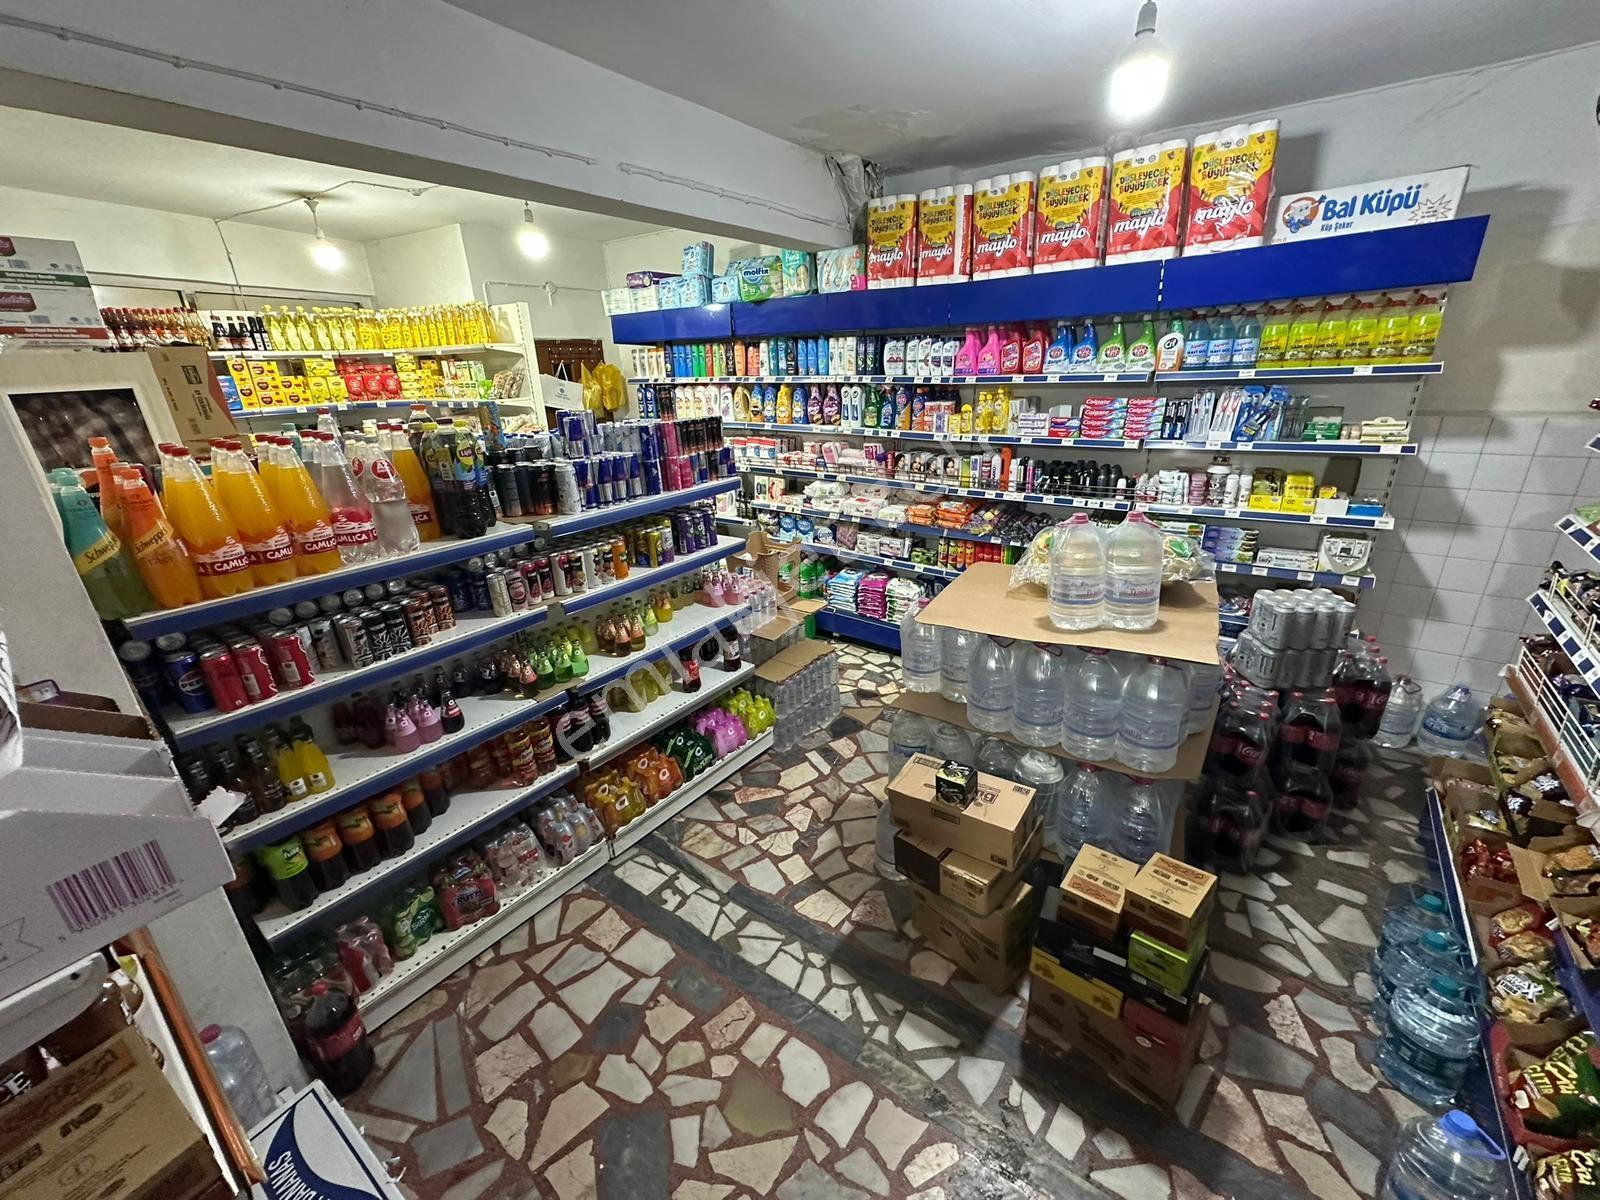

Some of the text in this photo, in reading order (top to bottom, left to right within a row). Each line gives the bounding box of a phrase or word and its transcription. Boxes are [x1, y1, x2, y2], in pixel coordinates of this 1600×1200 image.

[1194, 196, 1255, 225] maylo
[1322, 195, 1357, 221] Bal
[1359, 184, 1422, 217] Küpü
[1113, 208, 1168, 239] maylo
[1320, 221, 1354, 232] Küp Şeker
[1040, 223, 1089, 248] maylo
[920, 244, 953, 261] maylo
[976, 235, 1017, 257] maylo
[870, 247, 904, 266] maylo
[743, 267, 770, 277] molfix
[1165, 338, 1177, 349] Cif
